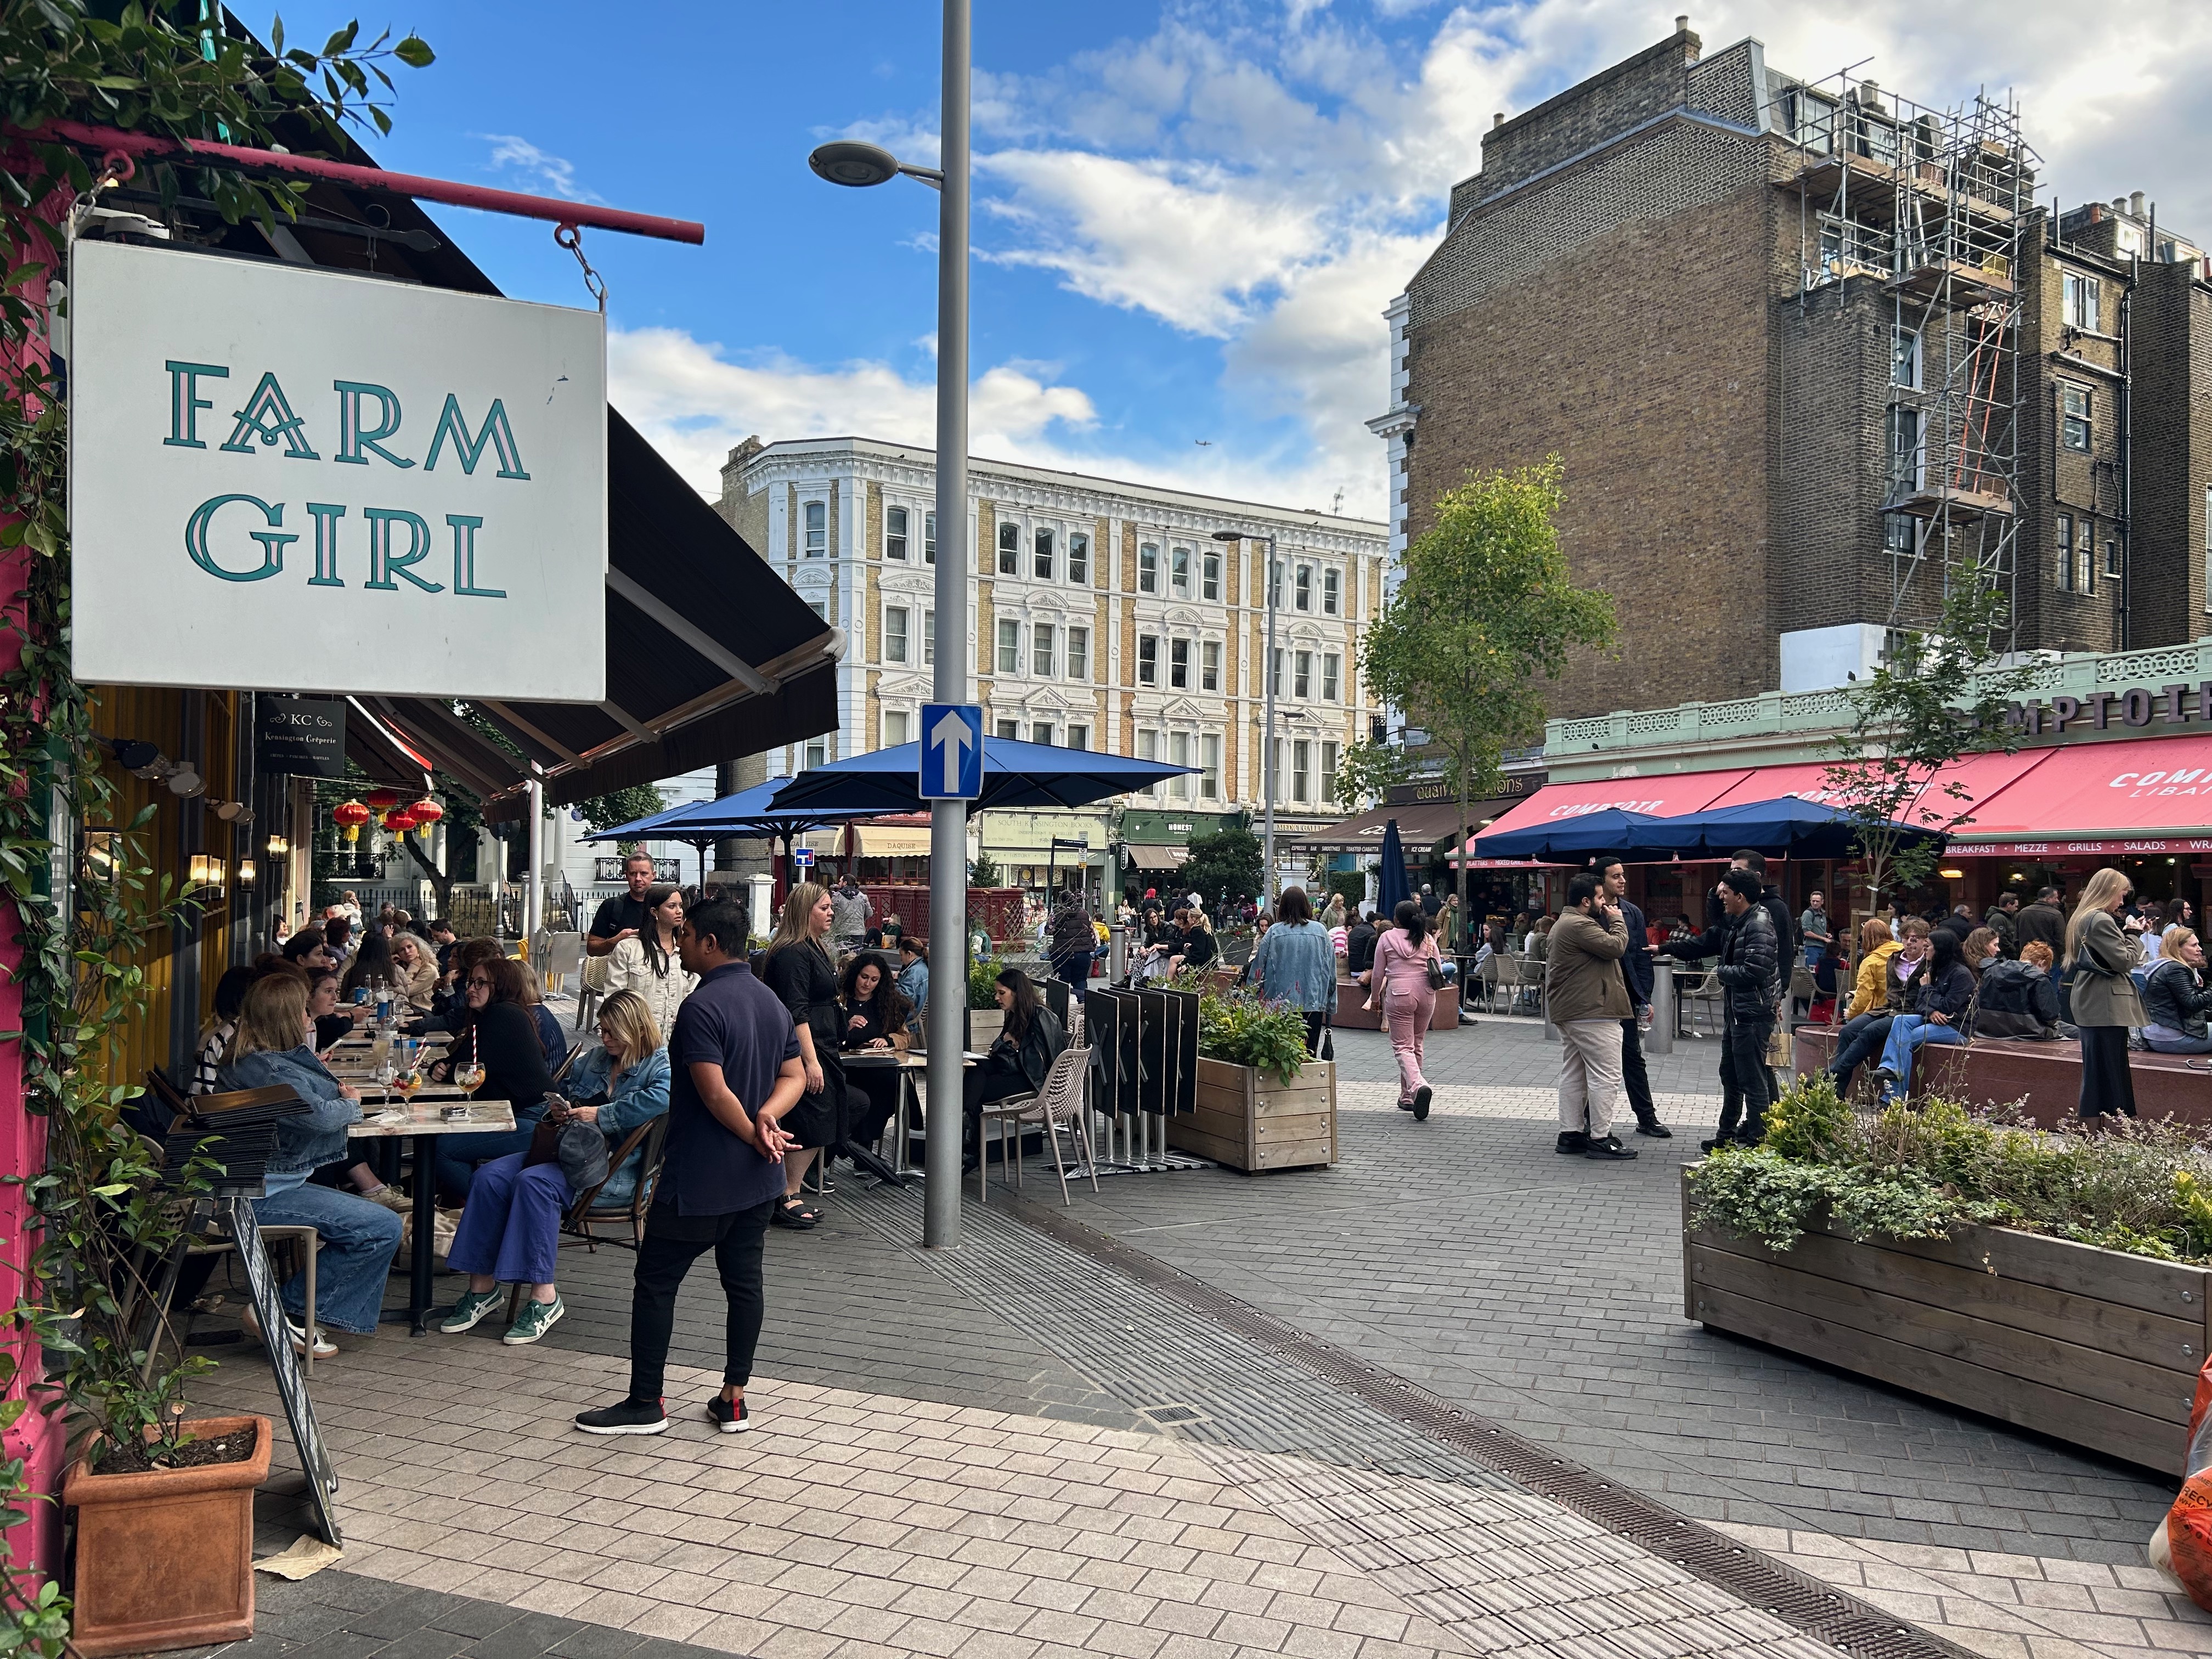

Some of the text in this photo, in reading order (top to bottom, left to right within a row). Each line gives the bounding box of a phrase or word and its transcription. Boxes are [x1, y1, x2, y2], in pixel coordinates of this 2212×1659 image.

[163, 359, 531, 481] FARM
[185, 493, 507, 598] GIRL
[291, 714, 312, 725] KC
[265, 731, 336, 744] Kensington Crêperie
[1168, 823, 1193, 832] HONEST
[1945, 844, 1996, 854] BREAKFAST
[2014, 843, 2048, 853] MEZZE
[2068, 843, 2102, 851] GRILLS
[2124, 841, 2166, 850] SALADS
